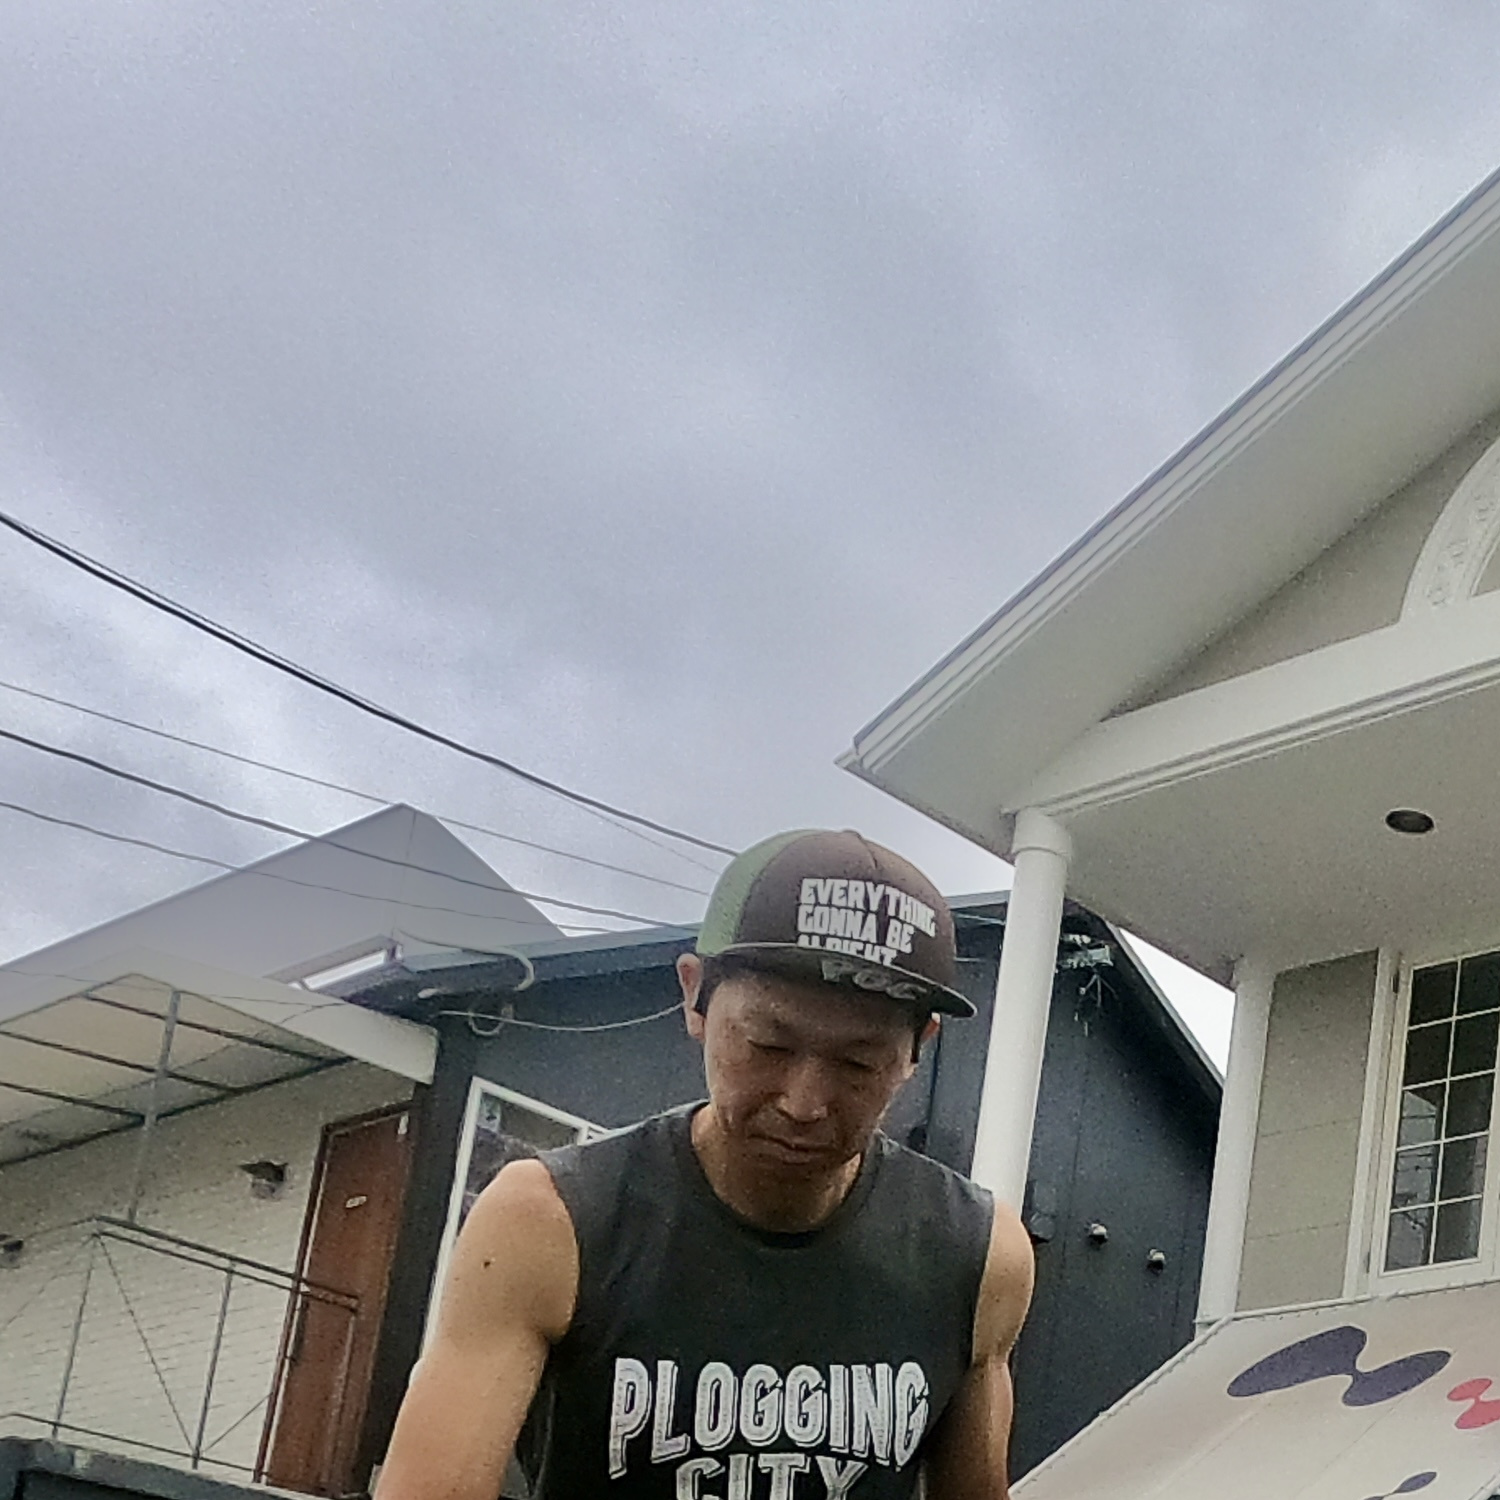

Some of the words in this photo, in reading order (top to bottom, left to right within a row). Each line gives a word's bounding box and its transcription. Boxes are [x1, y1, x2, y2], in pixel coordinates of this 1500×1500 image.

[798, 905, 877, 943] GONNA
[886, 918, 915, 954] BE
[608, 1357, 929, 1480] PLOGGING
